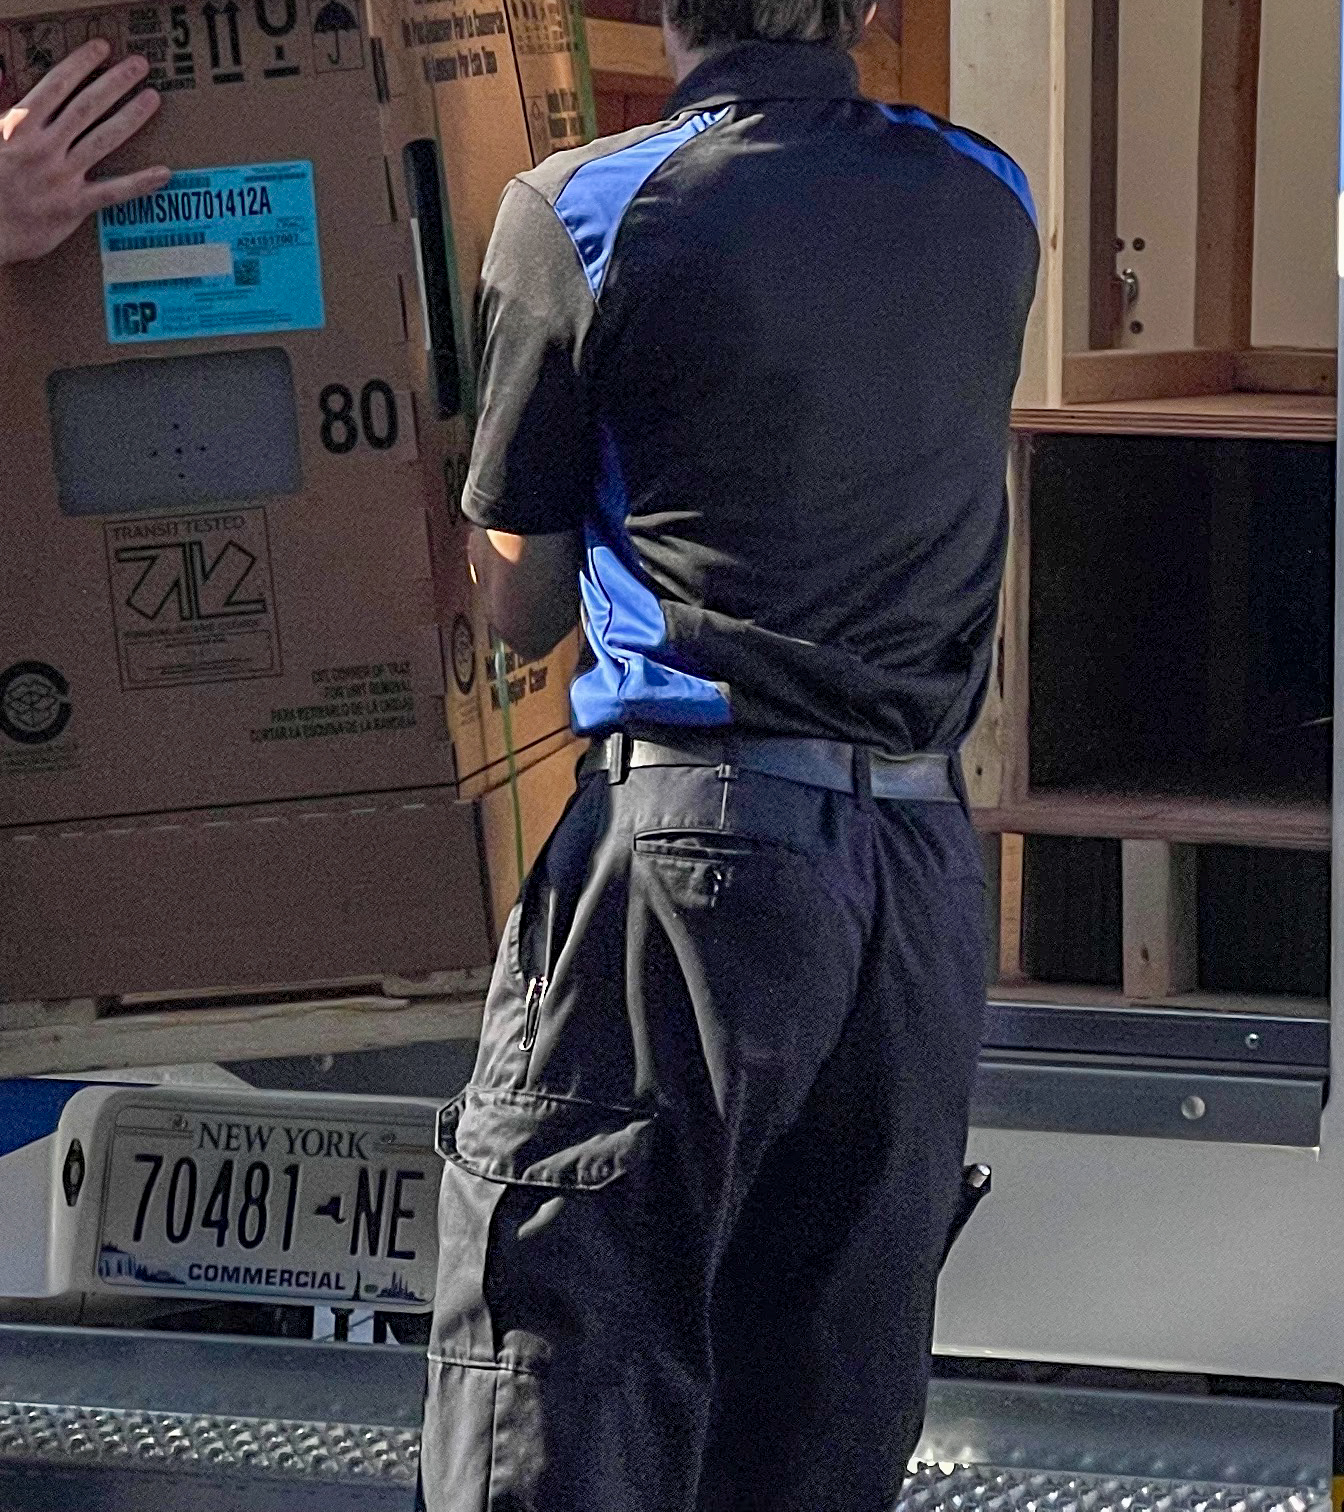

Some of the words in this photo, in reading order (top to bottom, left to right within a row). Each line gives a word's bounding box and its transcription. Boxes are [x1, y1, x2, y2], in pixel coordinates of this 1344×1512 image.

[112, 301, 157, 336] ICP
[318, 379, 399, 456] 80
[113, 521, 178, 540] TRANSIT
[185, 514, 246, 534] TESTED
[197, 1121, 277, 1155] NEW
[284, 1127, 370, 1161] YORK
[132, 1153, 300, 1253] 70481
[349, 1166, 425, 1261] NE
[188, 1262, 346, 1291] COMMERCIAL
